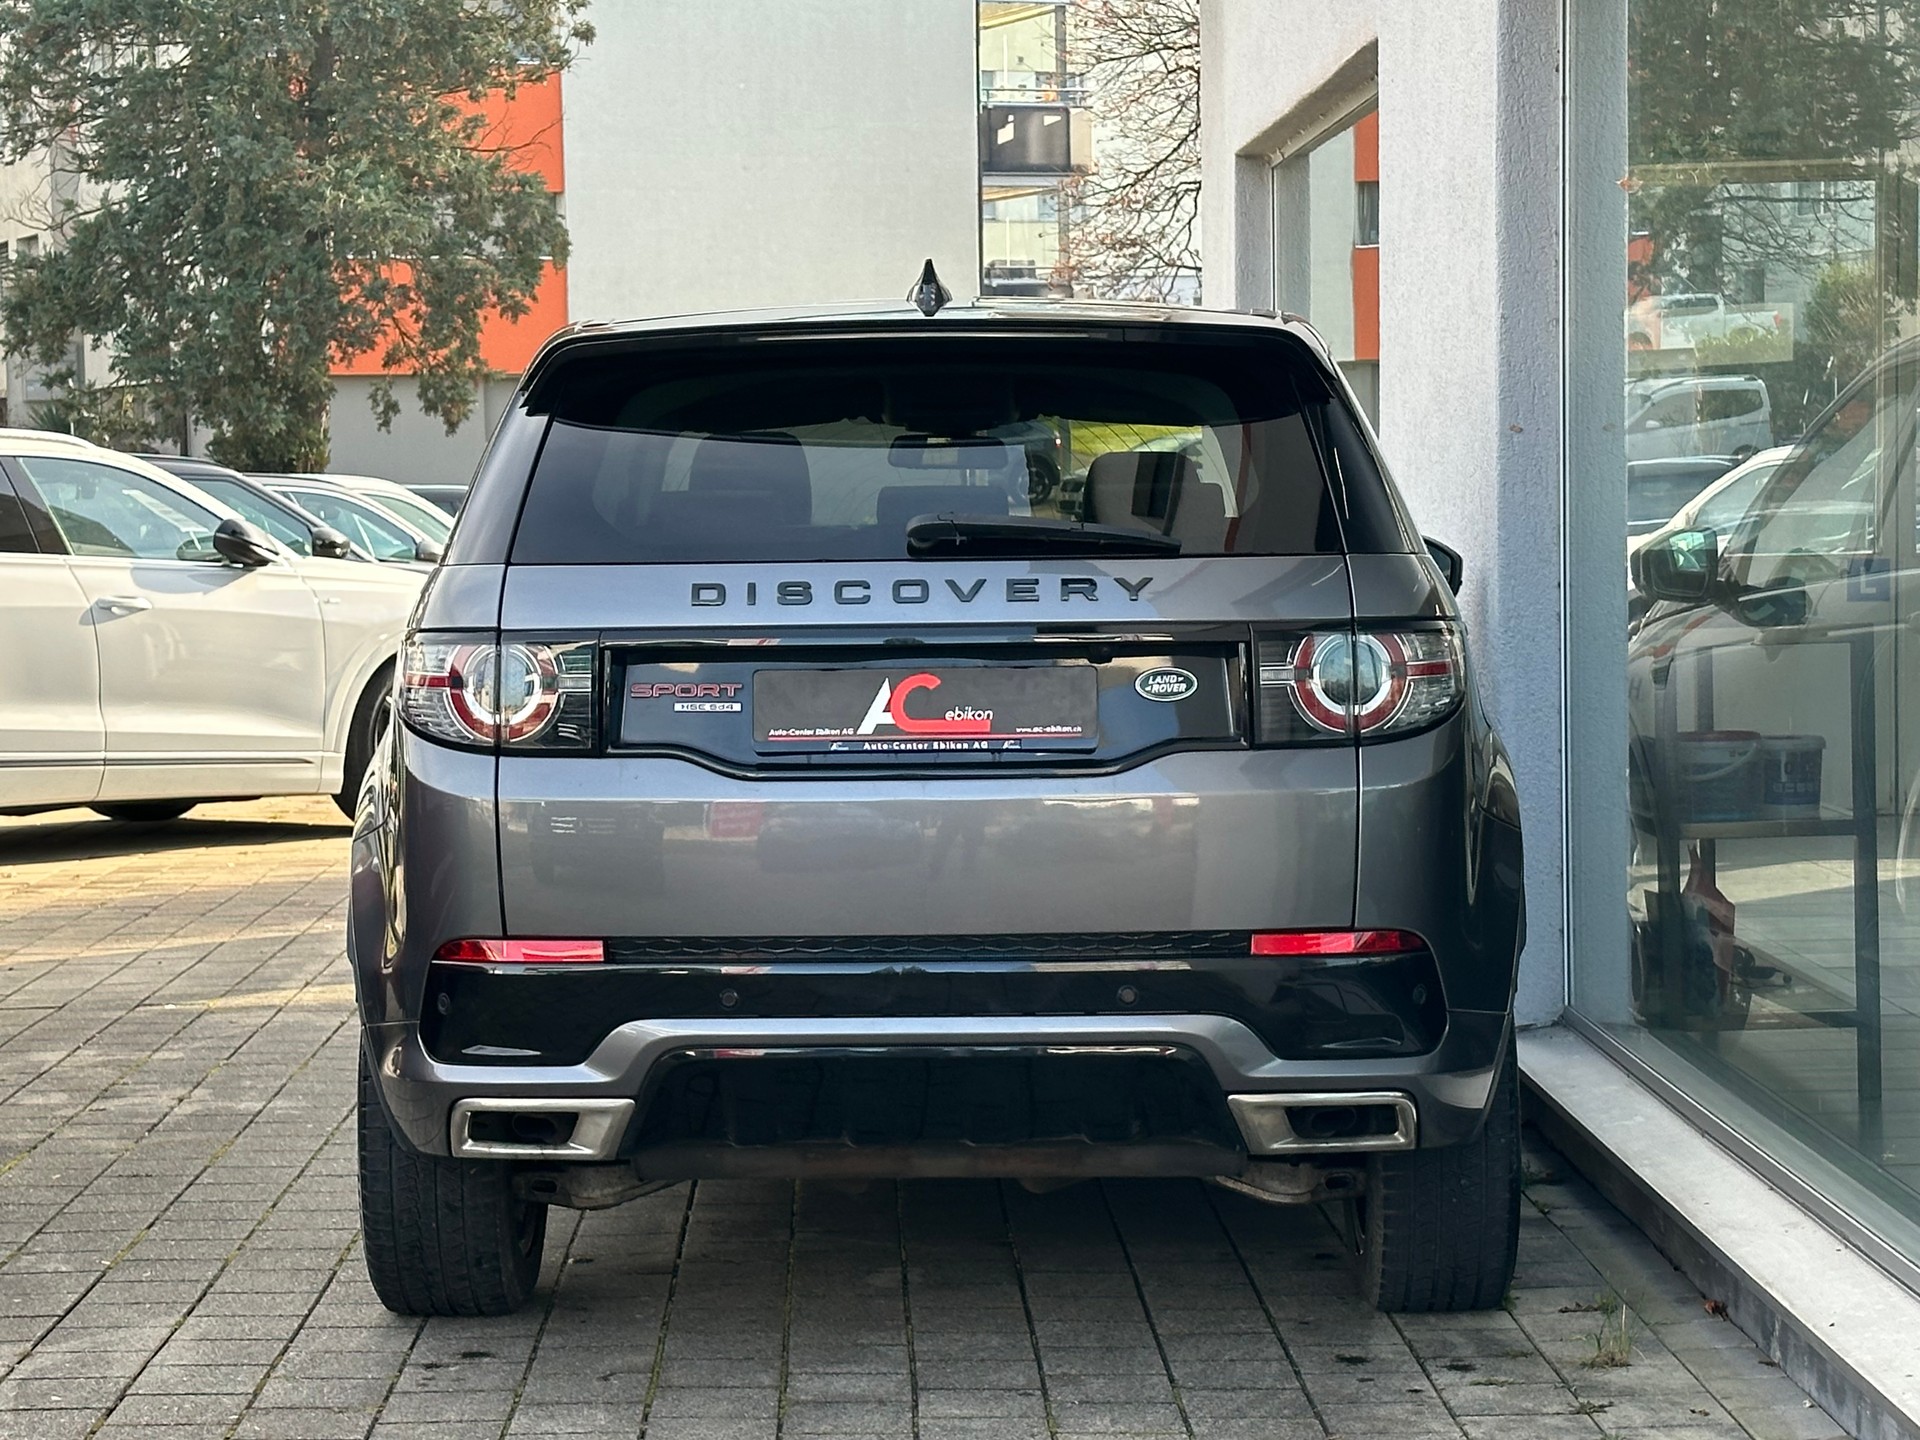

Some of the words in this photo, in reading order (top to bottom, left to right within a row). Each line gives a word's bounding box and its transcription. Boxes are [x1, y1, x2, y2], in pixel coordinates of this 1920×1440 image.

[691, 577, 1153, 606] DISCOVERY
[1148, 675, 1178, 684] LAND
[630, 683, 742, 697] SPORT
[1151, 683, 1187, 693] ROVER
[857, 672, 990, 734] AC
[945, 706, 993, 721] ebikon
[768, 728, 814, 736] Auto-Center
[815, 728, 840, 736] Ebikon
[841, 727, 854, 735] AG
[932, 741, 970, 750] Ebikon
[973, 740, 988, 749] AG
